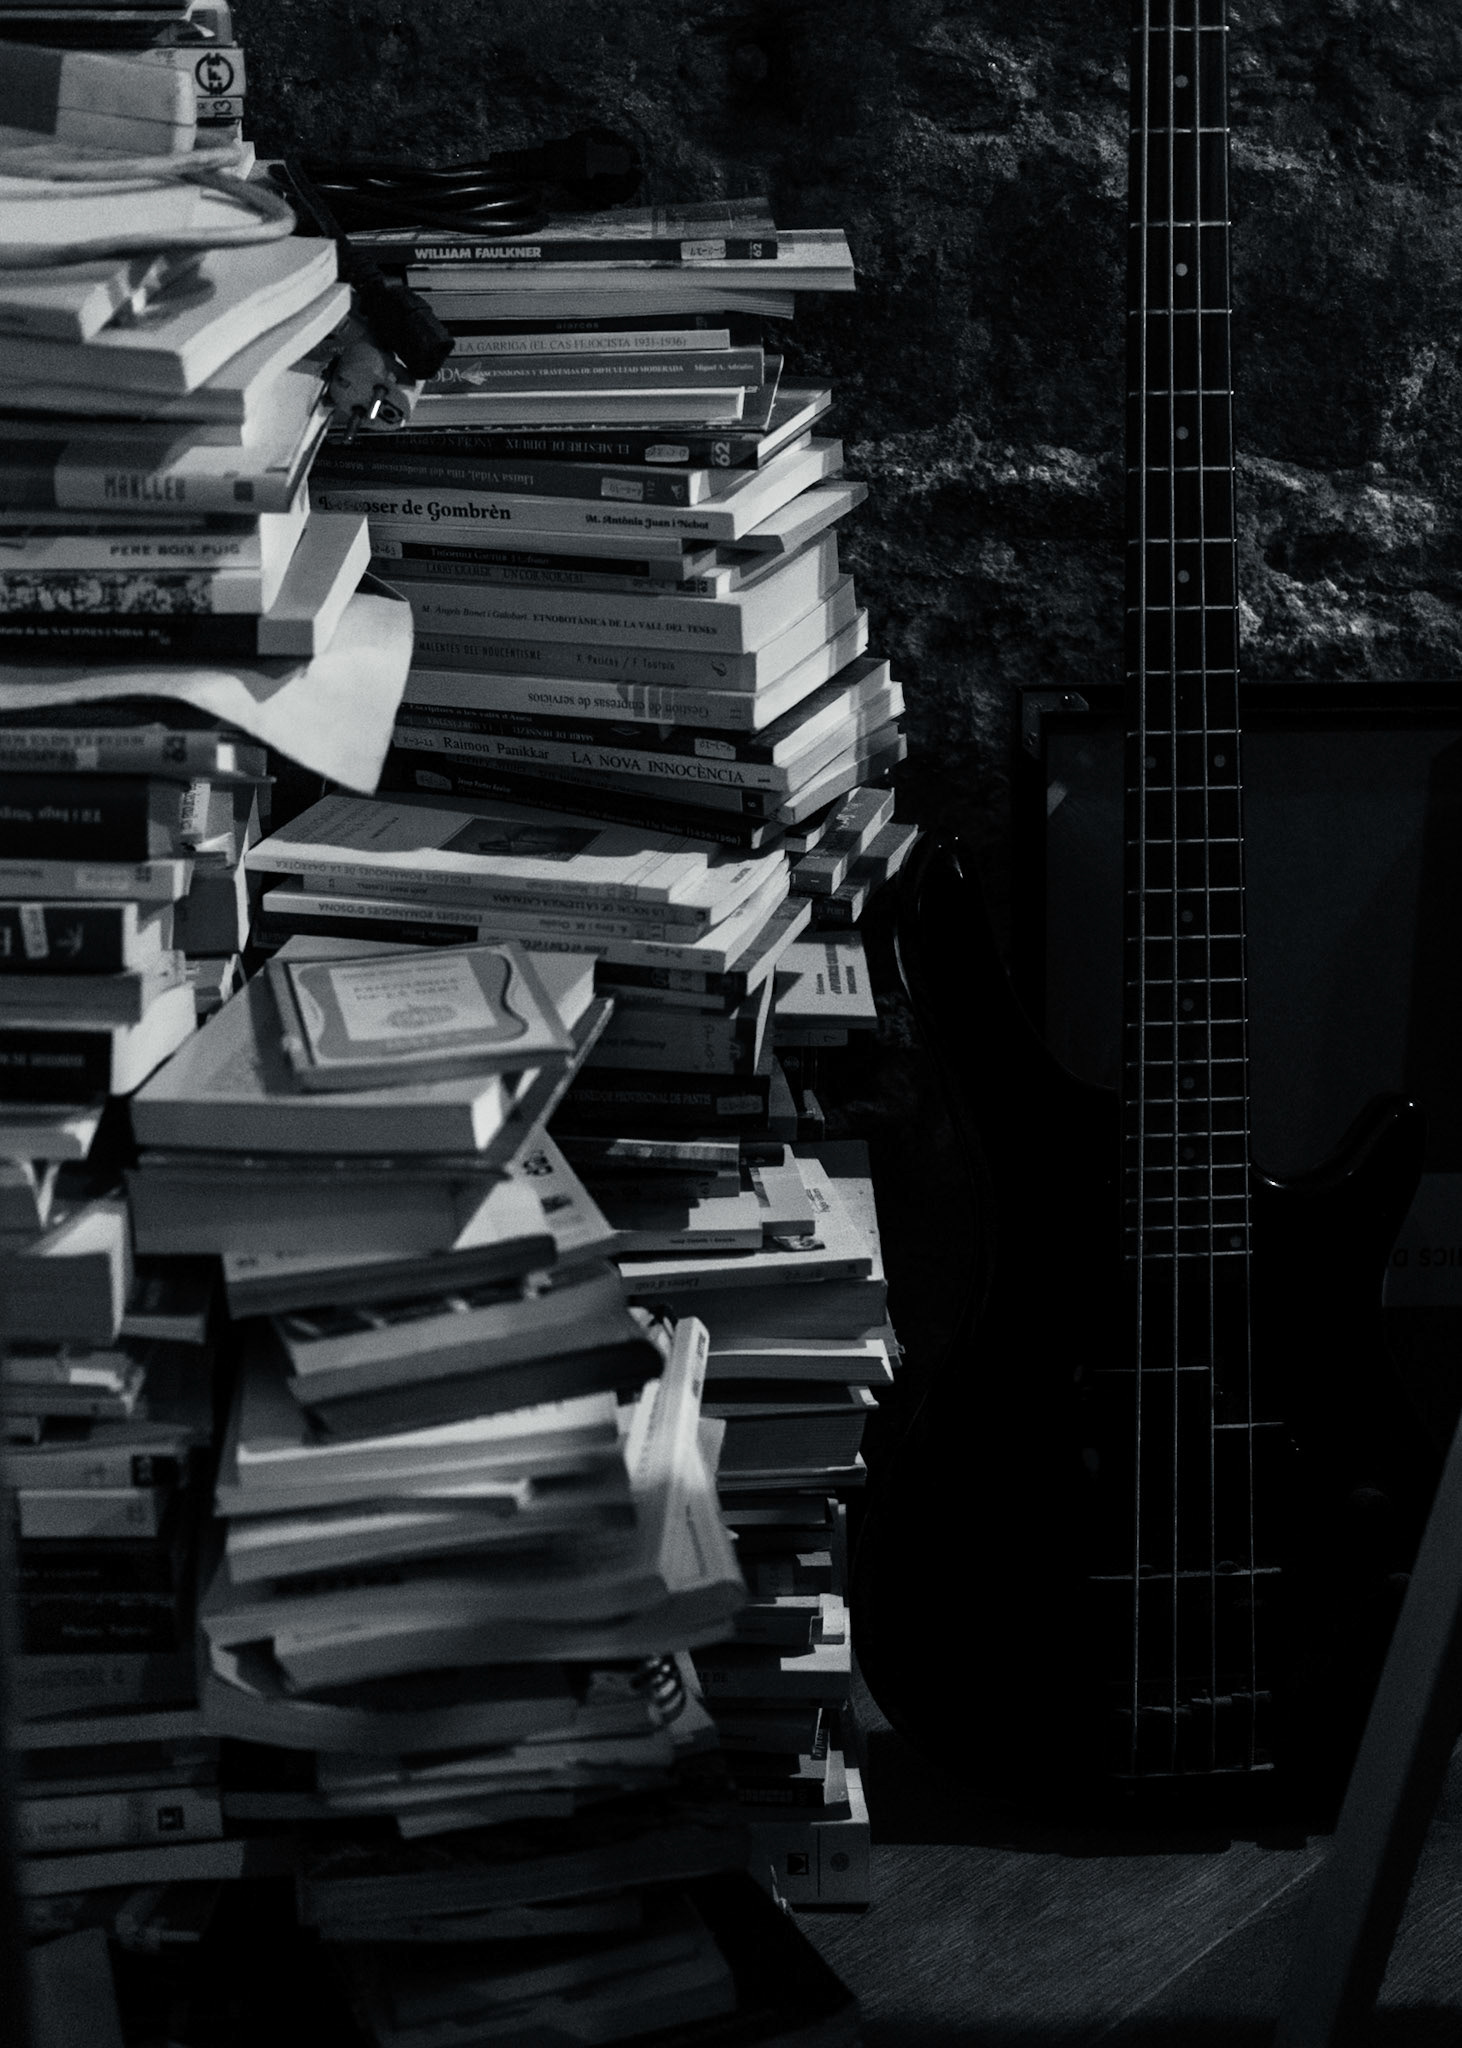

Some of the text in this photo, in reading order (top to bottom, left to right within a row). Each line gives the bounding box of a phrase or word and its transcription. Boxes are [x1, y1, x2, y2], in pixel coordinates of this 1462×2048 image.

[414, 246, 542, 260] WILLIAM FAULKNER
[459, 341, 474, 352] LA
[476, 340, 527, 352] GARRIGA
[549, 338, 571, 350] CAS
[640, 364, 684, 374] MODERADA
[568, 441, 613, 454] MESTRE
[617, 443, 632, 455] EL
[714, 441, 731, 467] 62
[103, 474, 187, 502] MANLLEU
[401, 499, 424, 516] de
[426, 499, 512, 522] Gombrèn
[585, 514, 601, 525] M.
[644, 516, 671, 530] Juan
[677, 519, 710, 530] Nebot
[109, 545, 152, 556] PERE
[201, 544, 241, 555] PUIG
[503, 567, 518, 579] UN
[609, 618, 622, 628] DE
[624, 619, 636, 629] LA
[637, 621, 663, 632] VALL
[664, 622, 683, 633] DEL
[685, 623, 719, 635] TENES
[463, 643, 479, 656] DEL
[481, 645, 542, 661] NOUCENTISME
[527, 692, 710, 720] Gestión de empresas de servicios
[555, 731, 568, 741] DE
[443, 736, 490, 753] Raimon
[497, 742, 551, 760] Panikkar
[572, 751, 593, 765] LA
[598, 754, 642, 771] NOVA
[648, 760, 745, 784] INNOCÈNCIA
[327, 864, 341, 876] LA
[342, 865, 356, 877] DE
[318, 902, 483, 924] ESGLÉSIES ROMÀNIQUES D'OSONA
[1419, 1247, 1462, 1267] ICS
